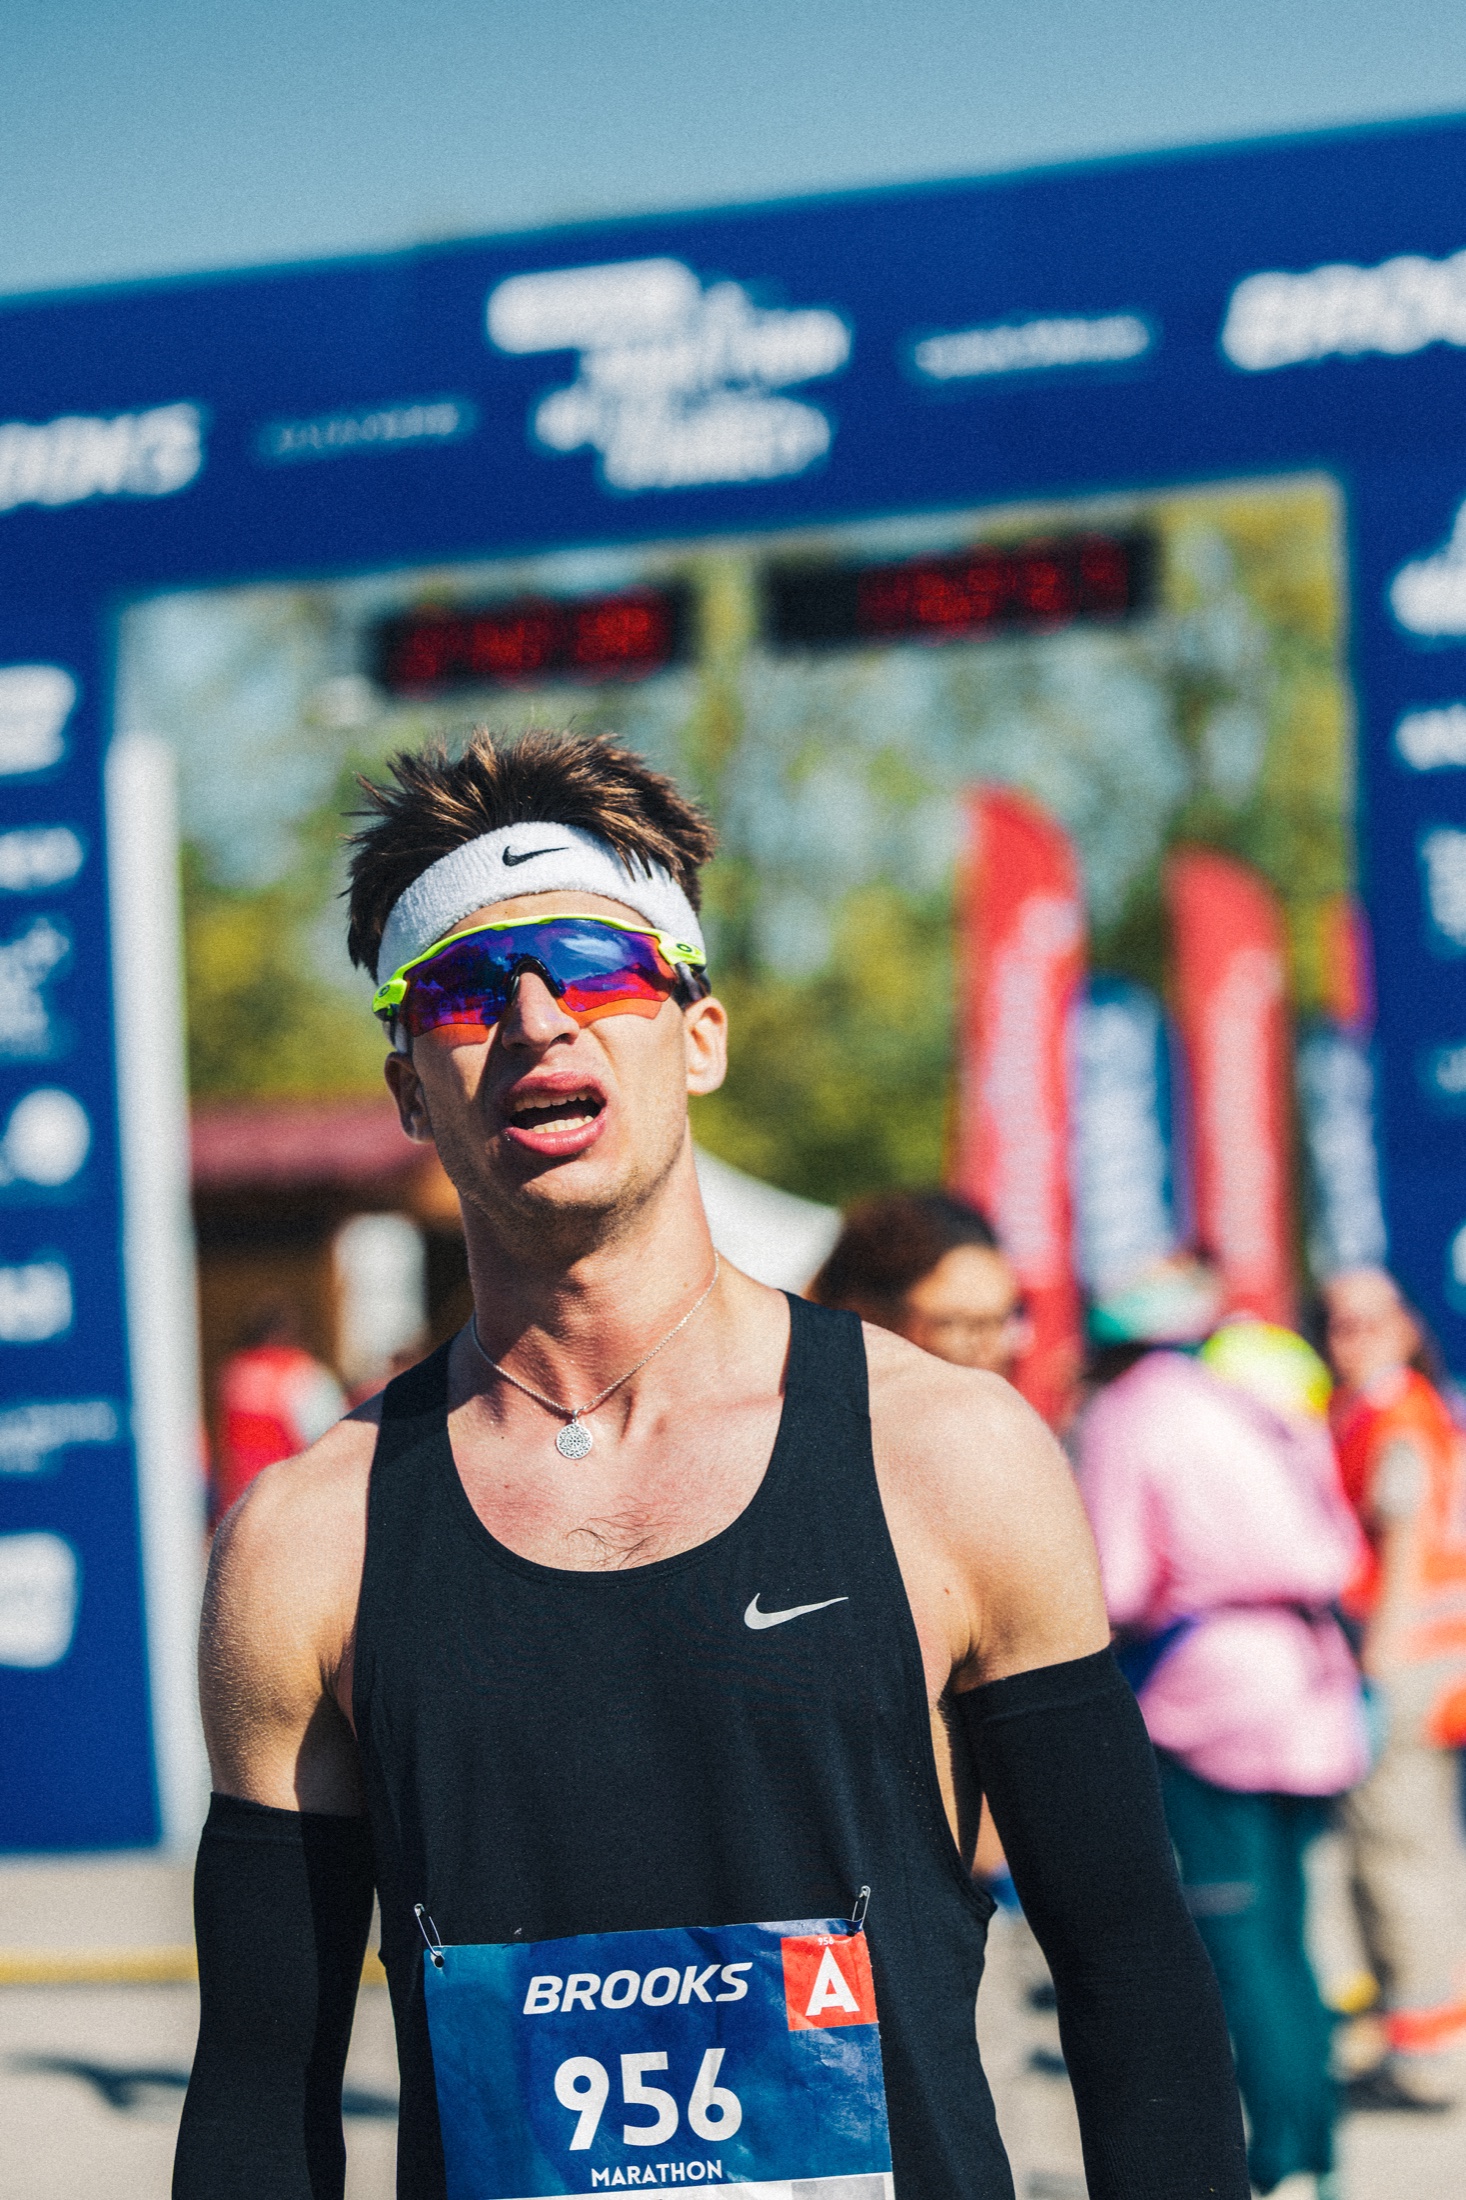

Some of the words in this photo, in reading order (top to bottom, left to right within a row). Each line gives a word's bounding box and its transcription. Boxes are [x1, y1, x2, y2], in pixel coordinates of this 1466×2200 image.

[817, 1937, 835, 1946] 956
[523, 1962, 753, 2015] BROOKS
[805, 1946, 861, 2017] A
[554, 2047, 742, 2151] 956
[591, 2159, 723, 2187] MARATHON
